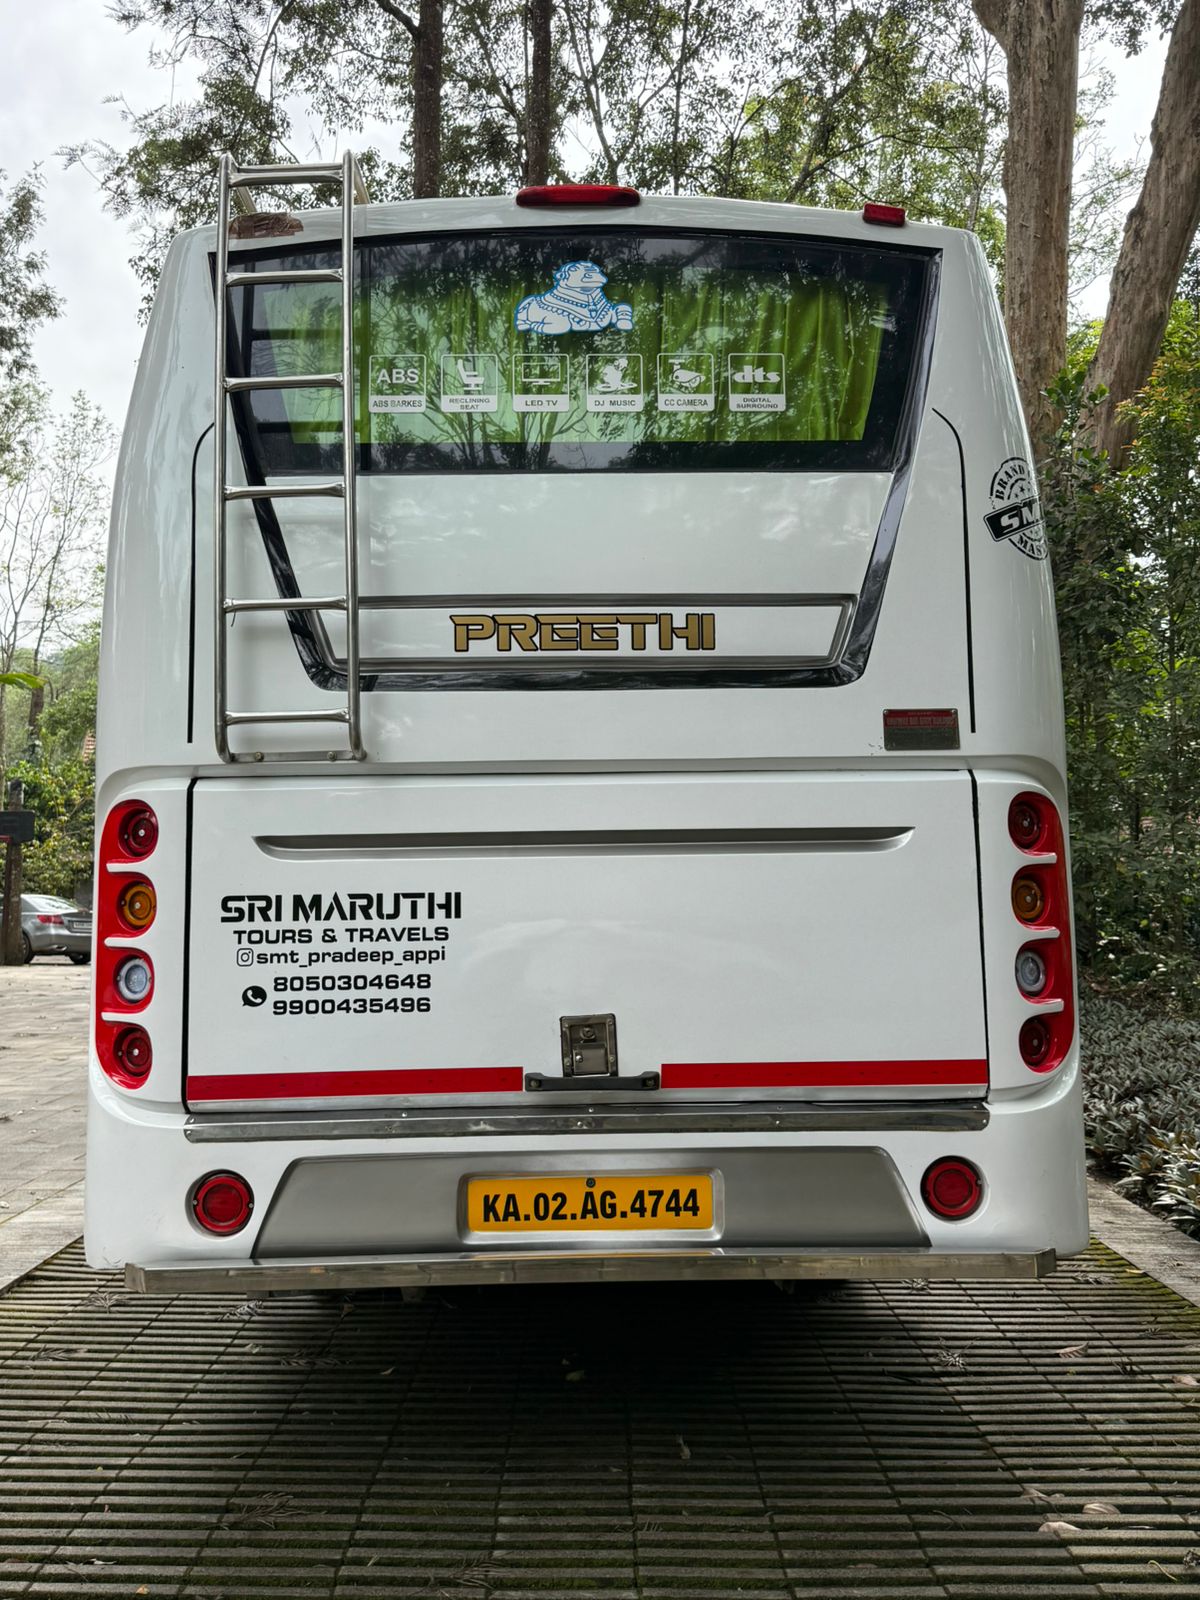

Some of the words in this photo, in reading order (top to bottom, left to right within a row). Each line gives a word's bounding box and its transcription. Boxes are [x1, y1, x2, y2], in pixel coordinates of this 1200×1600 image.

[376, 368, 419, 384] ABS
[733, 365, 781, 383] dts
[372, 400, 389, 408] ABS
[390, 400, 423, 408] BARKES
[609, 399, 636, 407] MUSIC
[664, 399, 675, 407] CC
[676, 399, 709, 407] CAMERA
[995, 464, 1025, 501] BRAND
[1017, 534, 1046, 556] MAS
[449, 613, 716, 652] PREETHI
[220, 894, 283, 923] SRI
[292, 891, 462, 924] MARUTHI
[233, 928, 313, 945] TOURS
[321, 928, 338, 943] &
[345, 926, 450, 943] TRAVELS
[256, 946, 446, 968] smt_pradeep_appi
[273, 973, 432, 992] 8050304648
[272, 997, 431, 1015] 9900435496
[482, 1188, 700, 1222] KA.02.AG.4744
